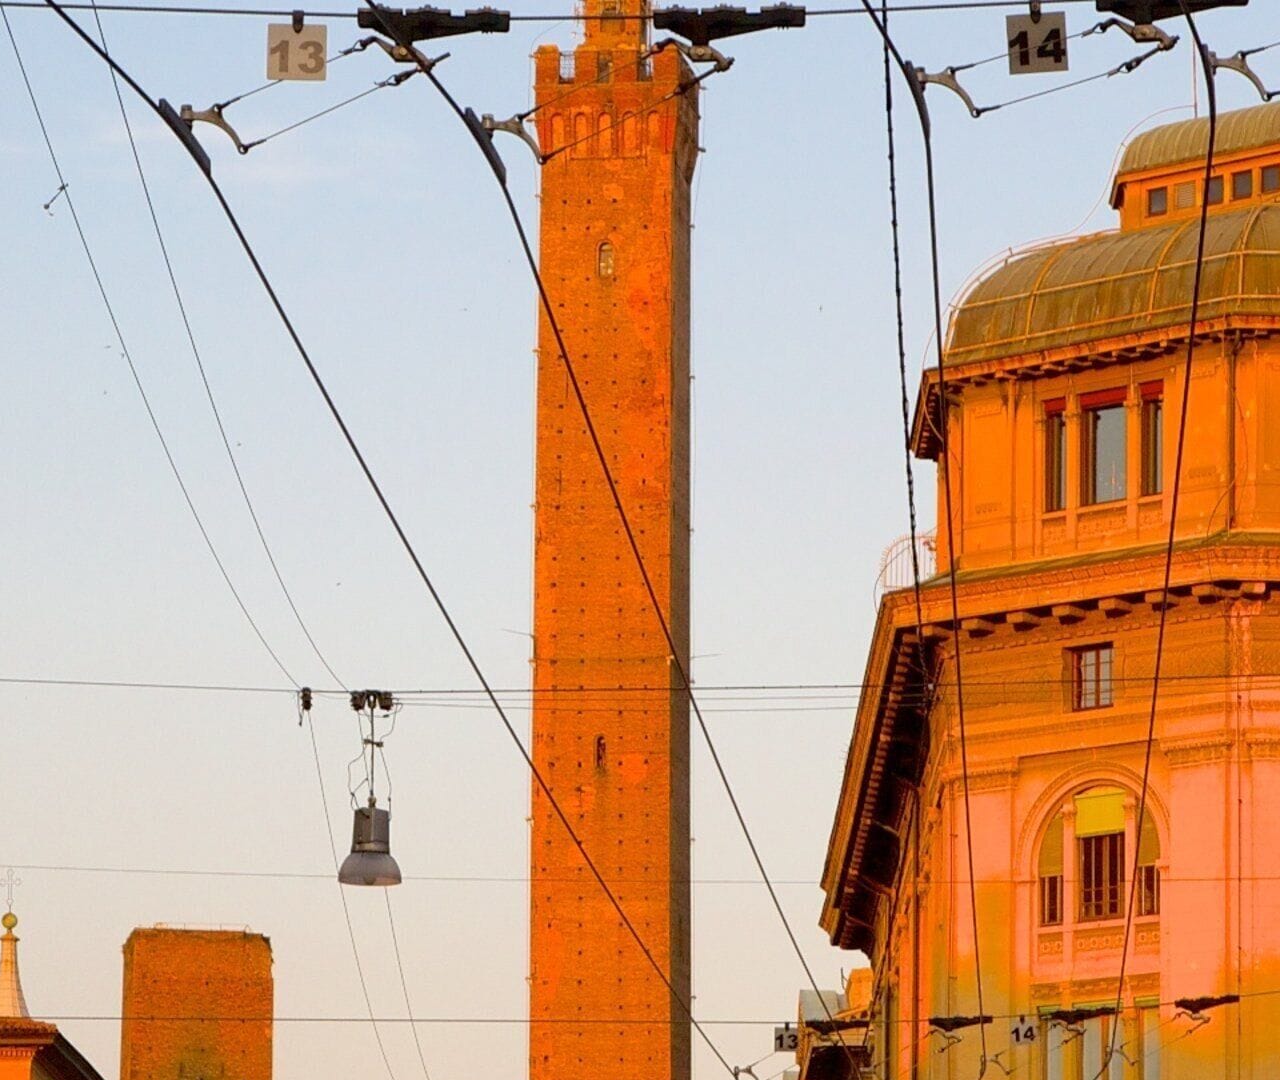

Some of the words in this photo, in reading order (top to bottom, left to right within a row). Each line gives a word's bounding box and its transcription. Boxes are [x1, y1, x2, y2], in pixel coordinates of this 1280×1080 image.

[270, 40, 324, 74] 13
[1009, 28, 1066, 65] 14
[775, 1034, 798, 1049] 13
[1011, 1026, 1036, 1042] 14
